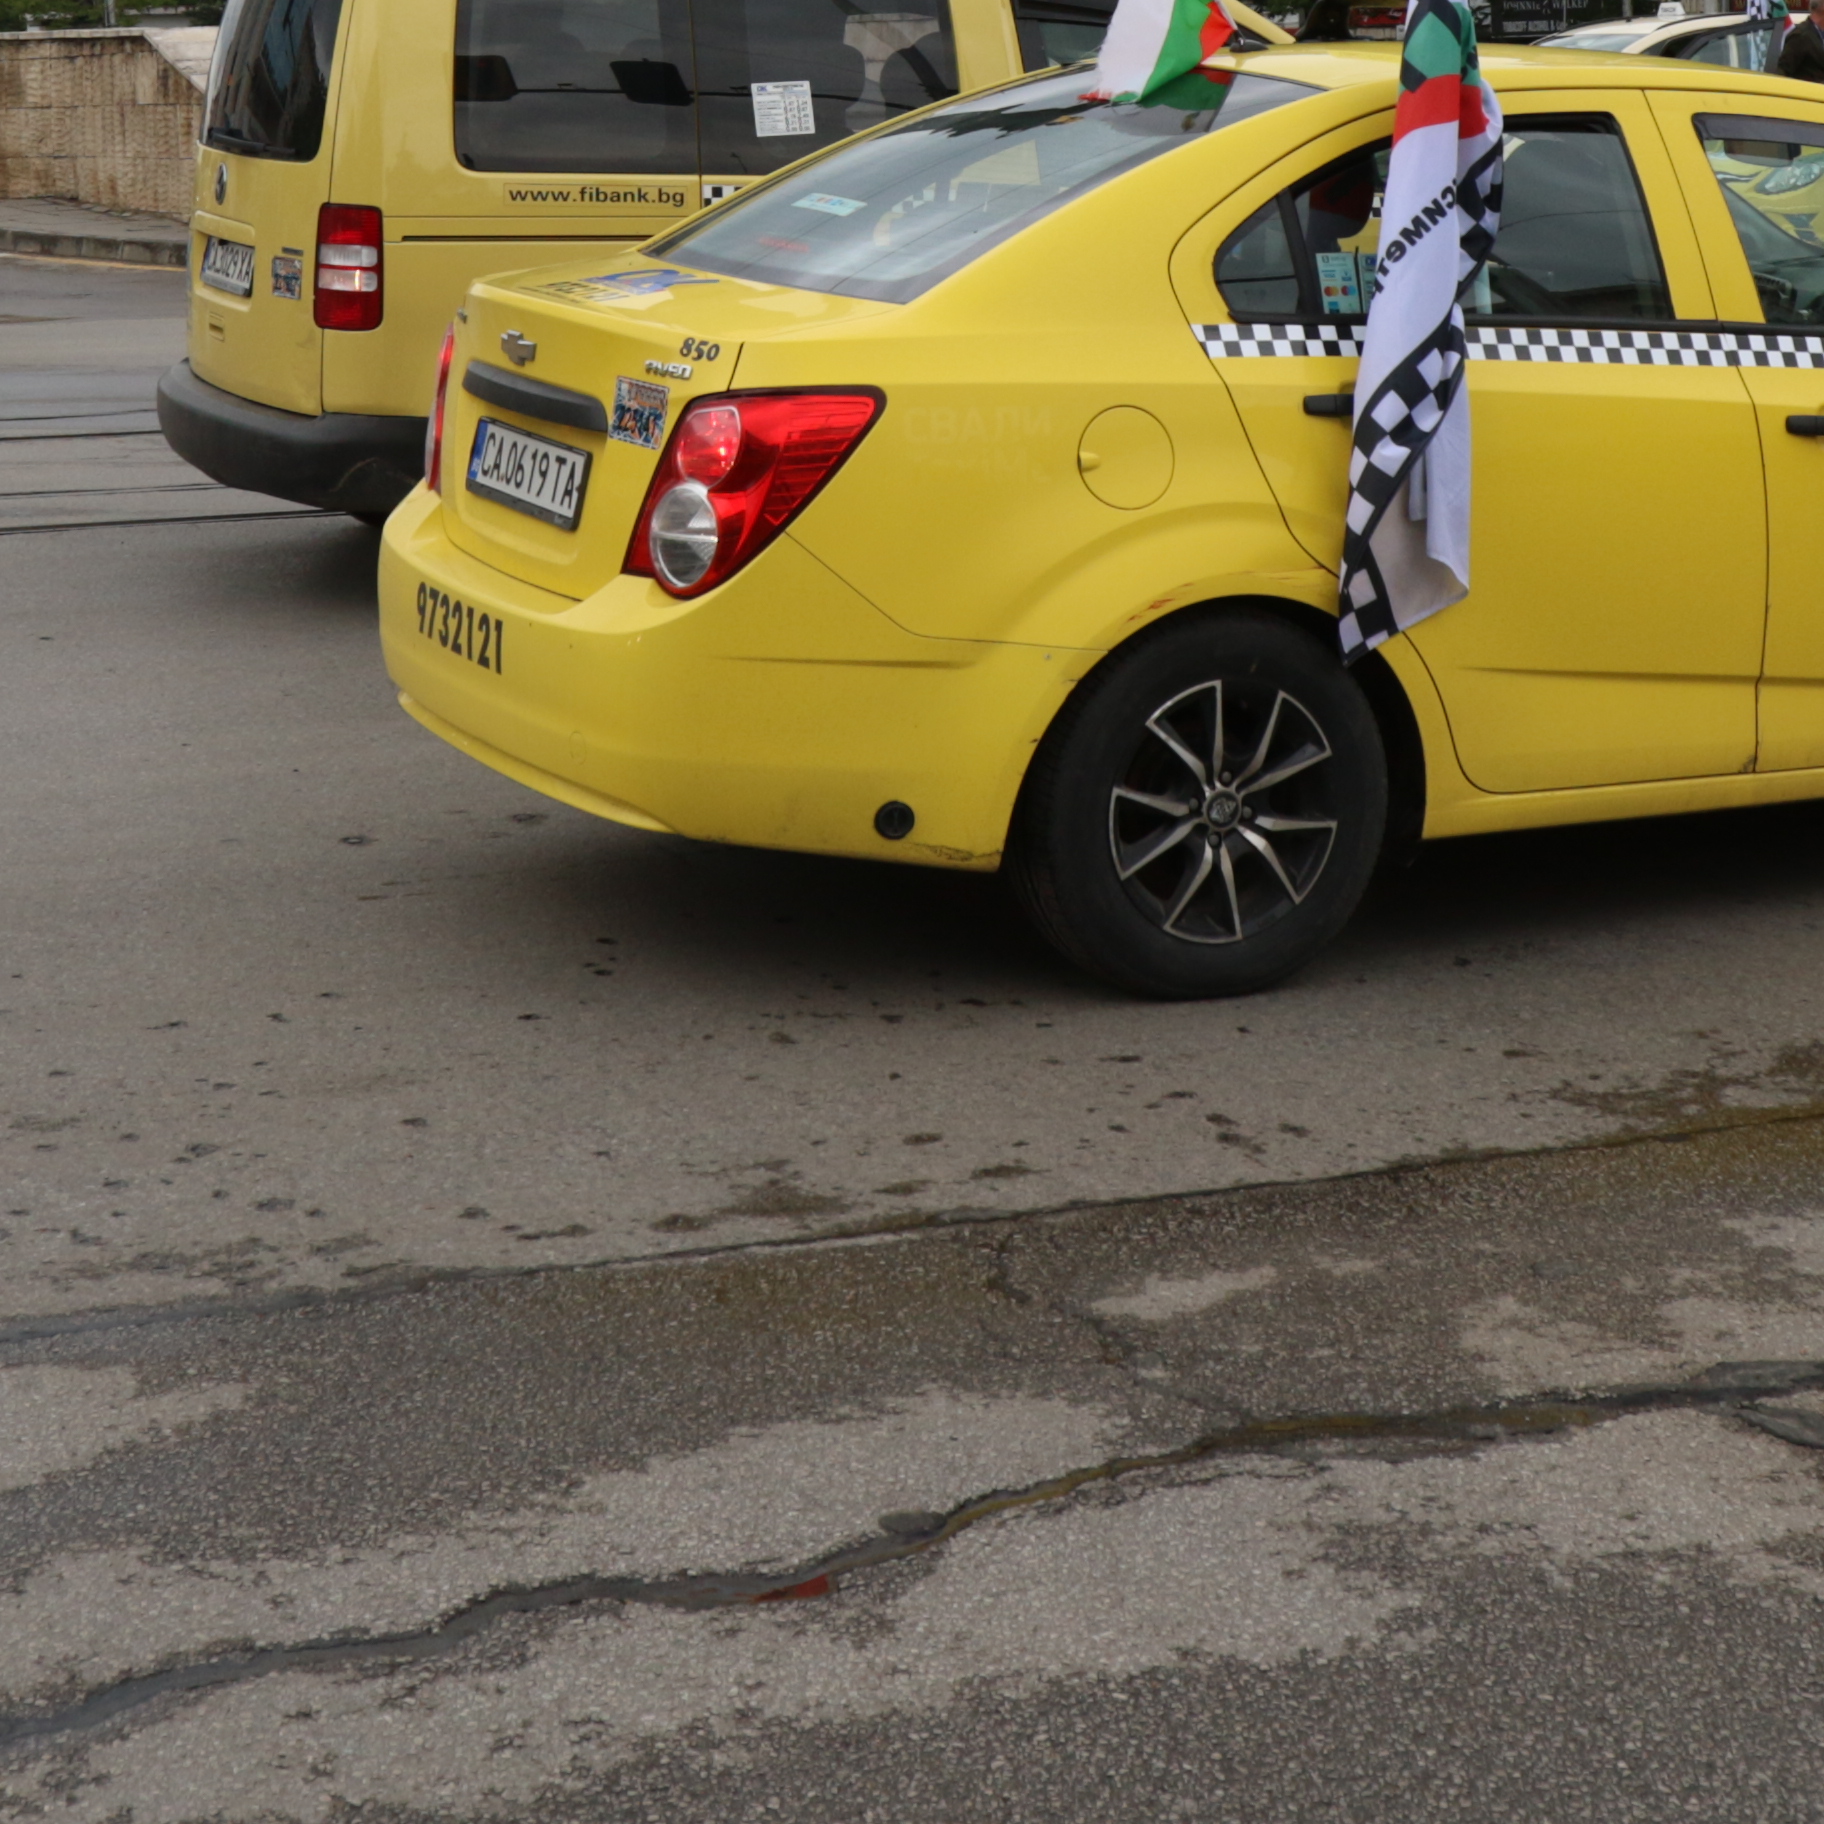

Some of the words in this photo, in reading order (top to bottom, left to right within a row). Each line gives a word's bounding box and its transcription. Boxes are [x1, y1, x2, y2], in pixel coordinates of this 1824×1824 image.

[509, 186, 685, 207] www.fibank.bg
[679, 337, 720, 361] 850
[416, 581, 504, 676] 9732121
